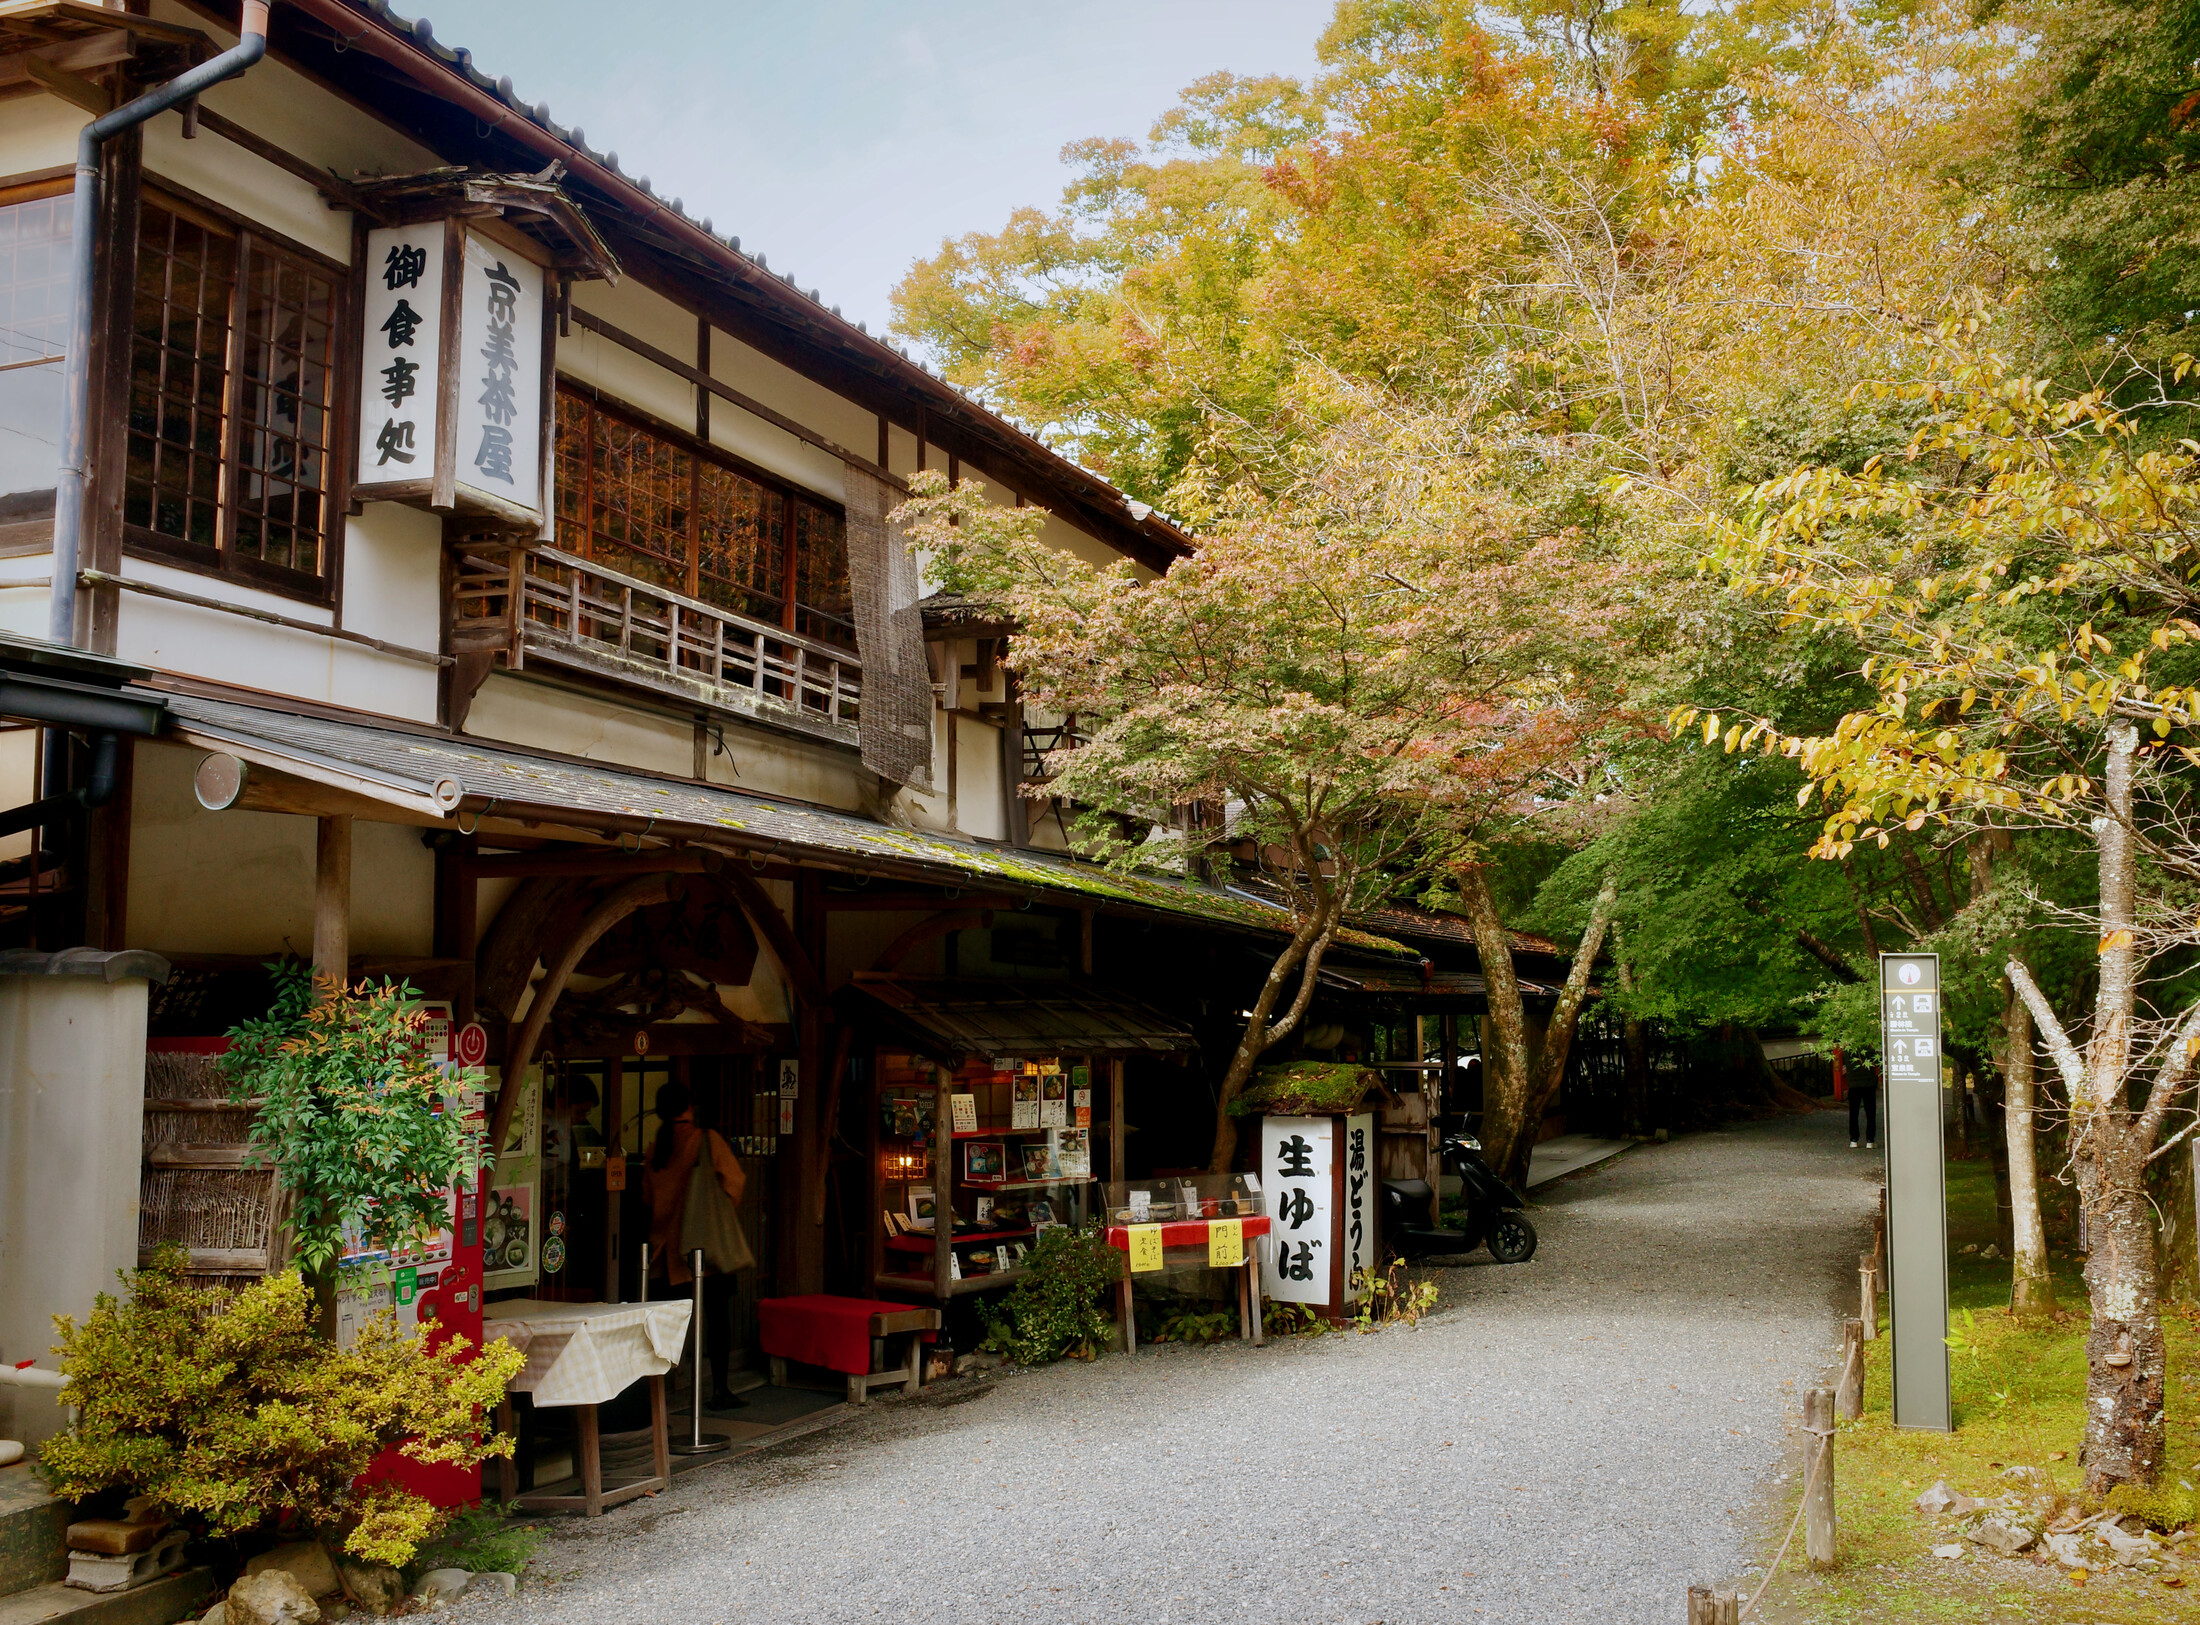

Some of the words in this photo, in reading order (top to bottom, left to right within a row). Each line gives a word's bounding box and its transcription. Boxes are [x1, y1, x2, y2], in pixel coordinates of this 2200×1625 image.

[376, 244, 426, 466] 御食事処
[474, 261, 521, 485] 京美茶屋
[1150, 1227, 1160, 1261] ゆばそば
[1215, 1225, 1228, 1259] 門前
[1277, 1134, 1322, 1281] 生ゆば
